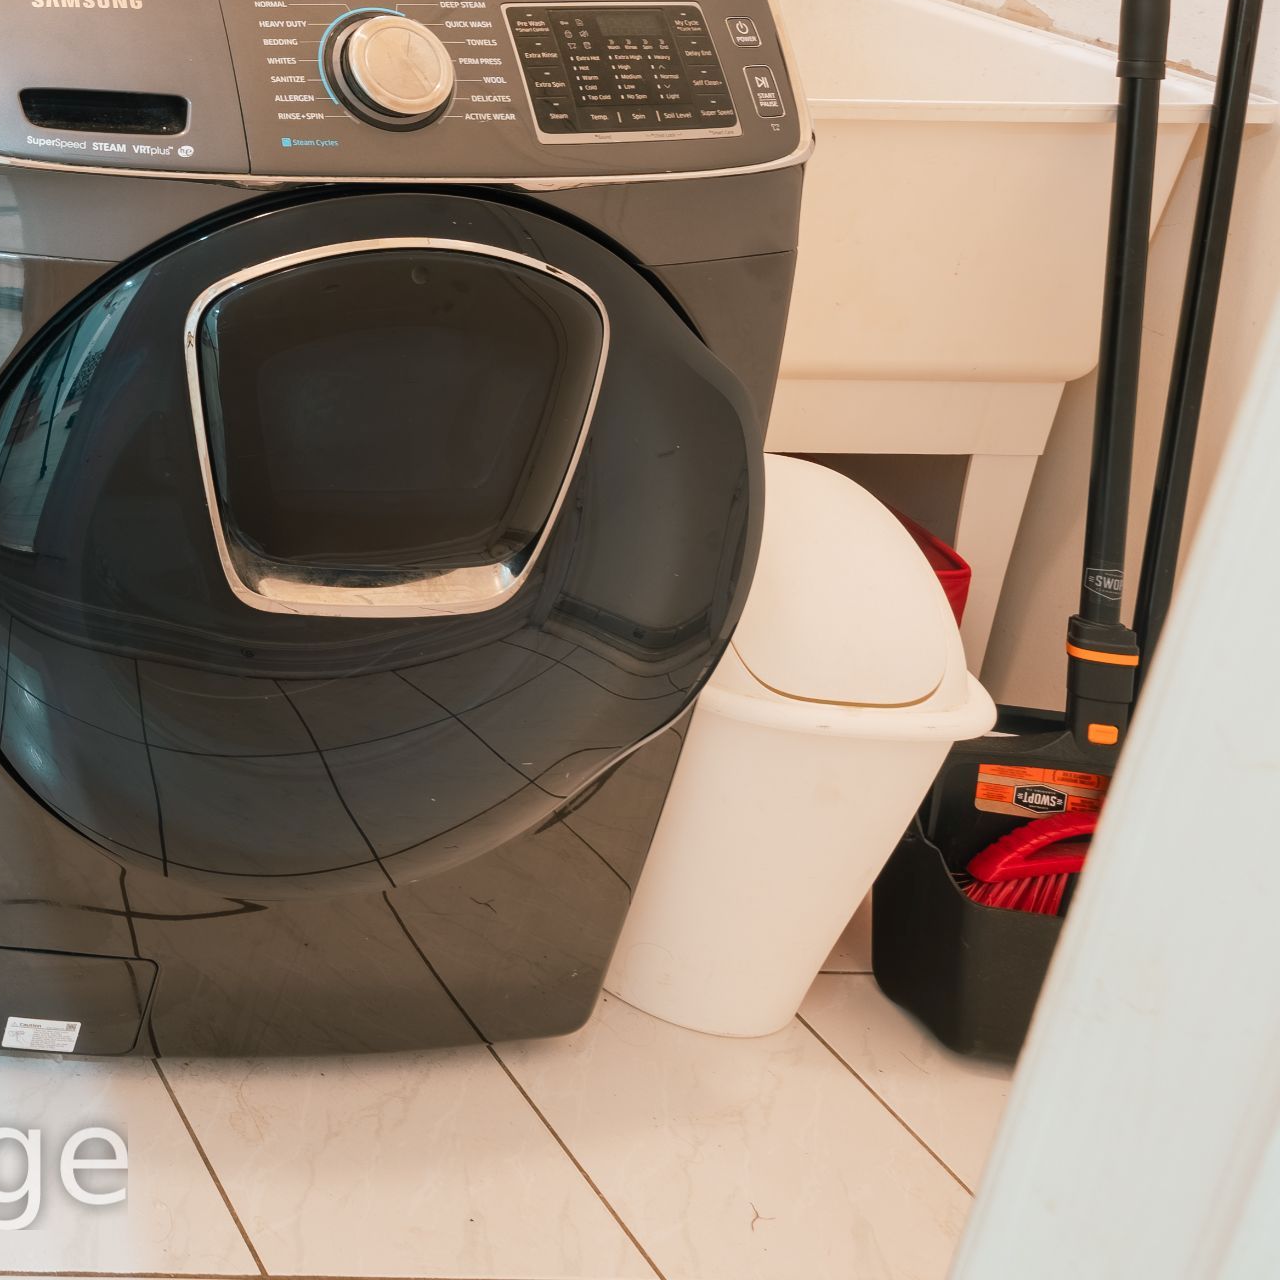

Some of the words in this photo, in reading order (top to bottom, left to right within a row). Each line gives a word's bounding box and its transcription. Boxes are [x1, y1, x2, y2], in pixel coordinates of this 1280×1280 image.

[460, 1, 486, 9] STEAM
[259, 20, 284, 28] HEAVY
[285, 20, 307, 28] DUTY
[263, 38, 298, 46] BEDDING
[267, 57, 297, 65] WHITES
[270, 75, 306, 83] SANITIZE
[483, 76, 507, 84] WOOL
[274, 94, 315, 102] ALLERGEN
[471, 95, 512, 103] DELICATES
[278, 112, 324, 120] RINSE+SPIN
[465, 113, 492, 121] ACTIVE
[493, 113, 516, 121] WEAR
[27, 135, 87, 150] SuperSpeed
[92, 142, 127, 153] STEAM
[316, 139, 339, 147] Cycles
[1023, 792, 1057, 808] SWOPT
